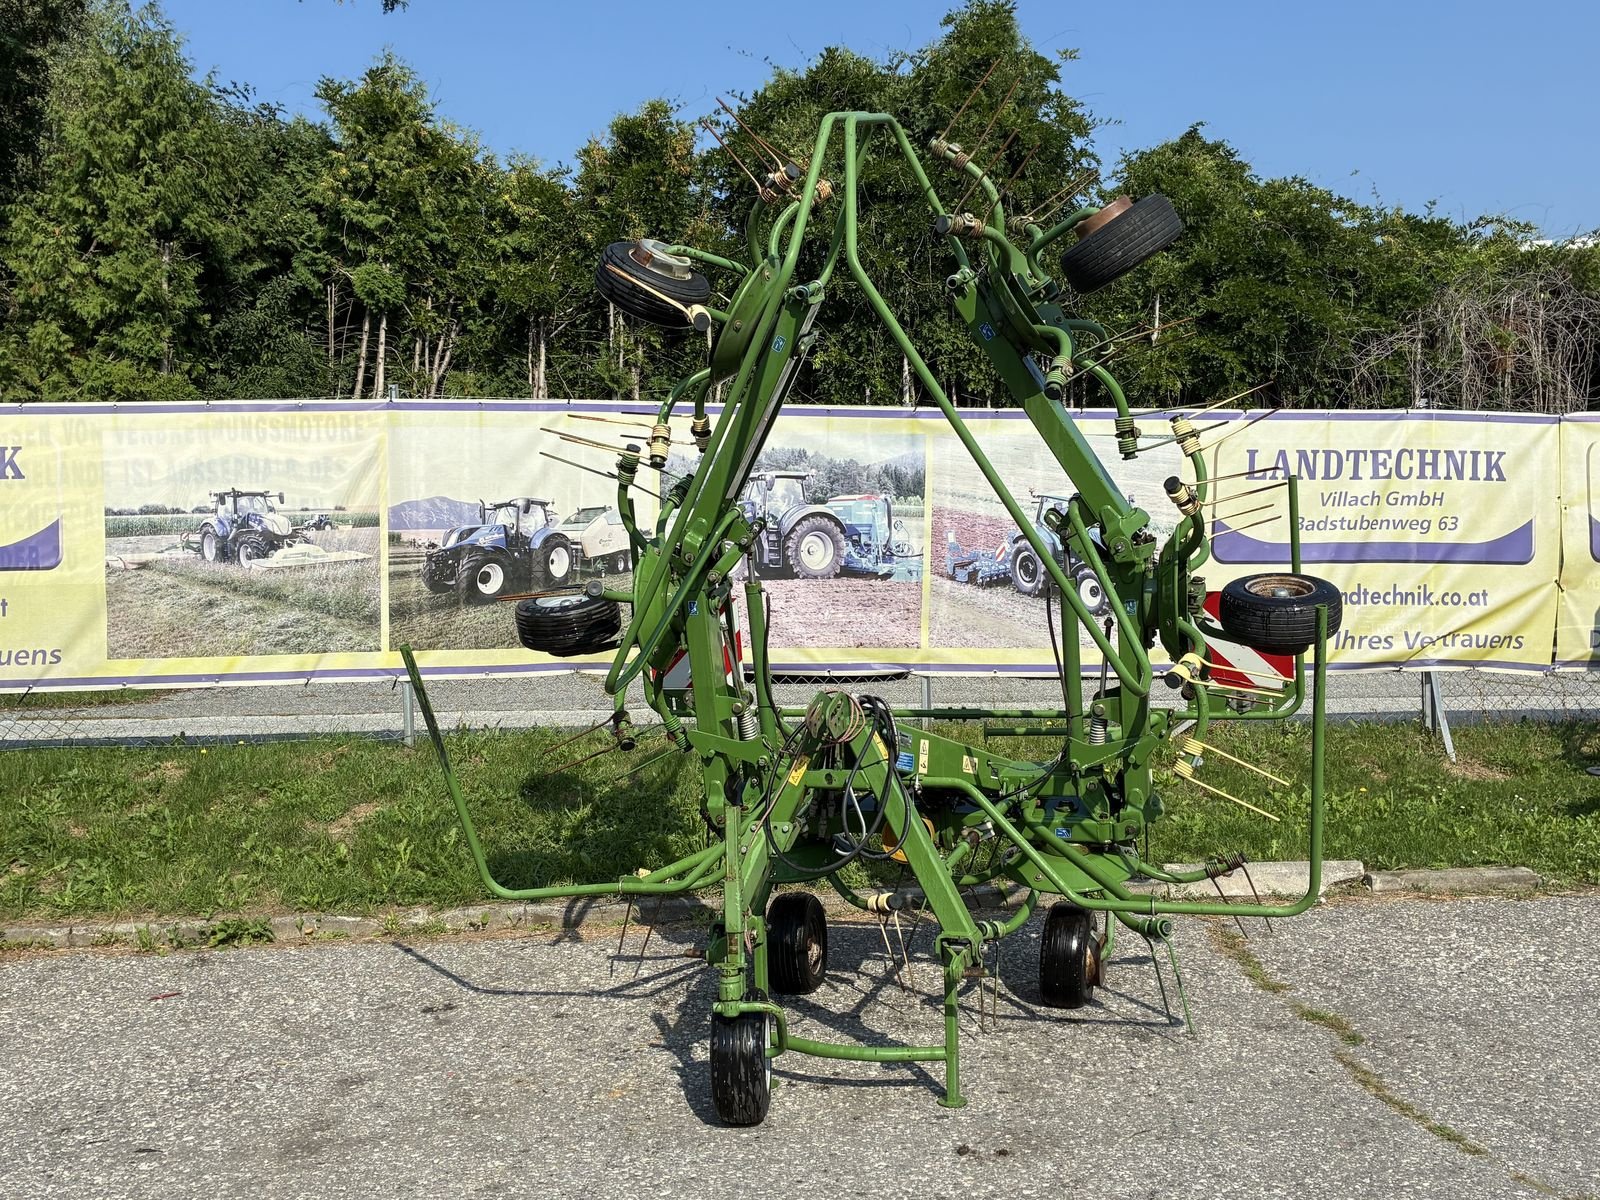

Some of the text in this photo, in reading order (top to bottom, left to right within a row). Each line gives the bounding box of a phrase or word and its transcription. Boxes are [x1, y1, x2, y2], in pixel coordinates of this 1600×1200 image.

[1245, 448, 1507, 482] LANDTECHNIK
[1320, 491, 1445, 507] Villach GmbH
[1437, 516, 1459, 531] 63
[1341, 583, 1489, 607] ndtechnik.co.at
[1334, 629, 1394, 650] Ihres
[0, 648, 62, 666] uens
